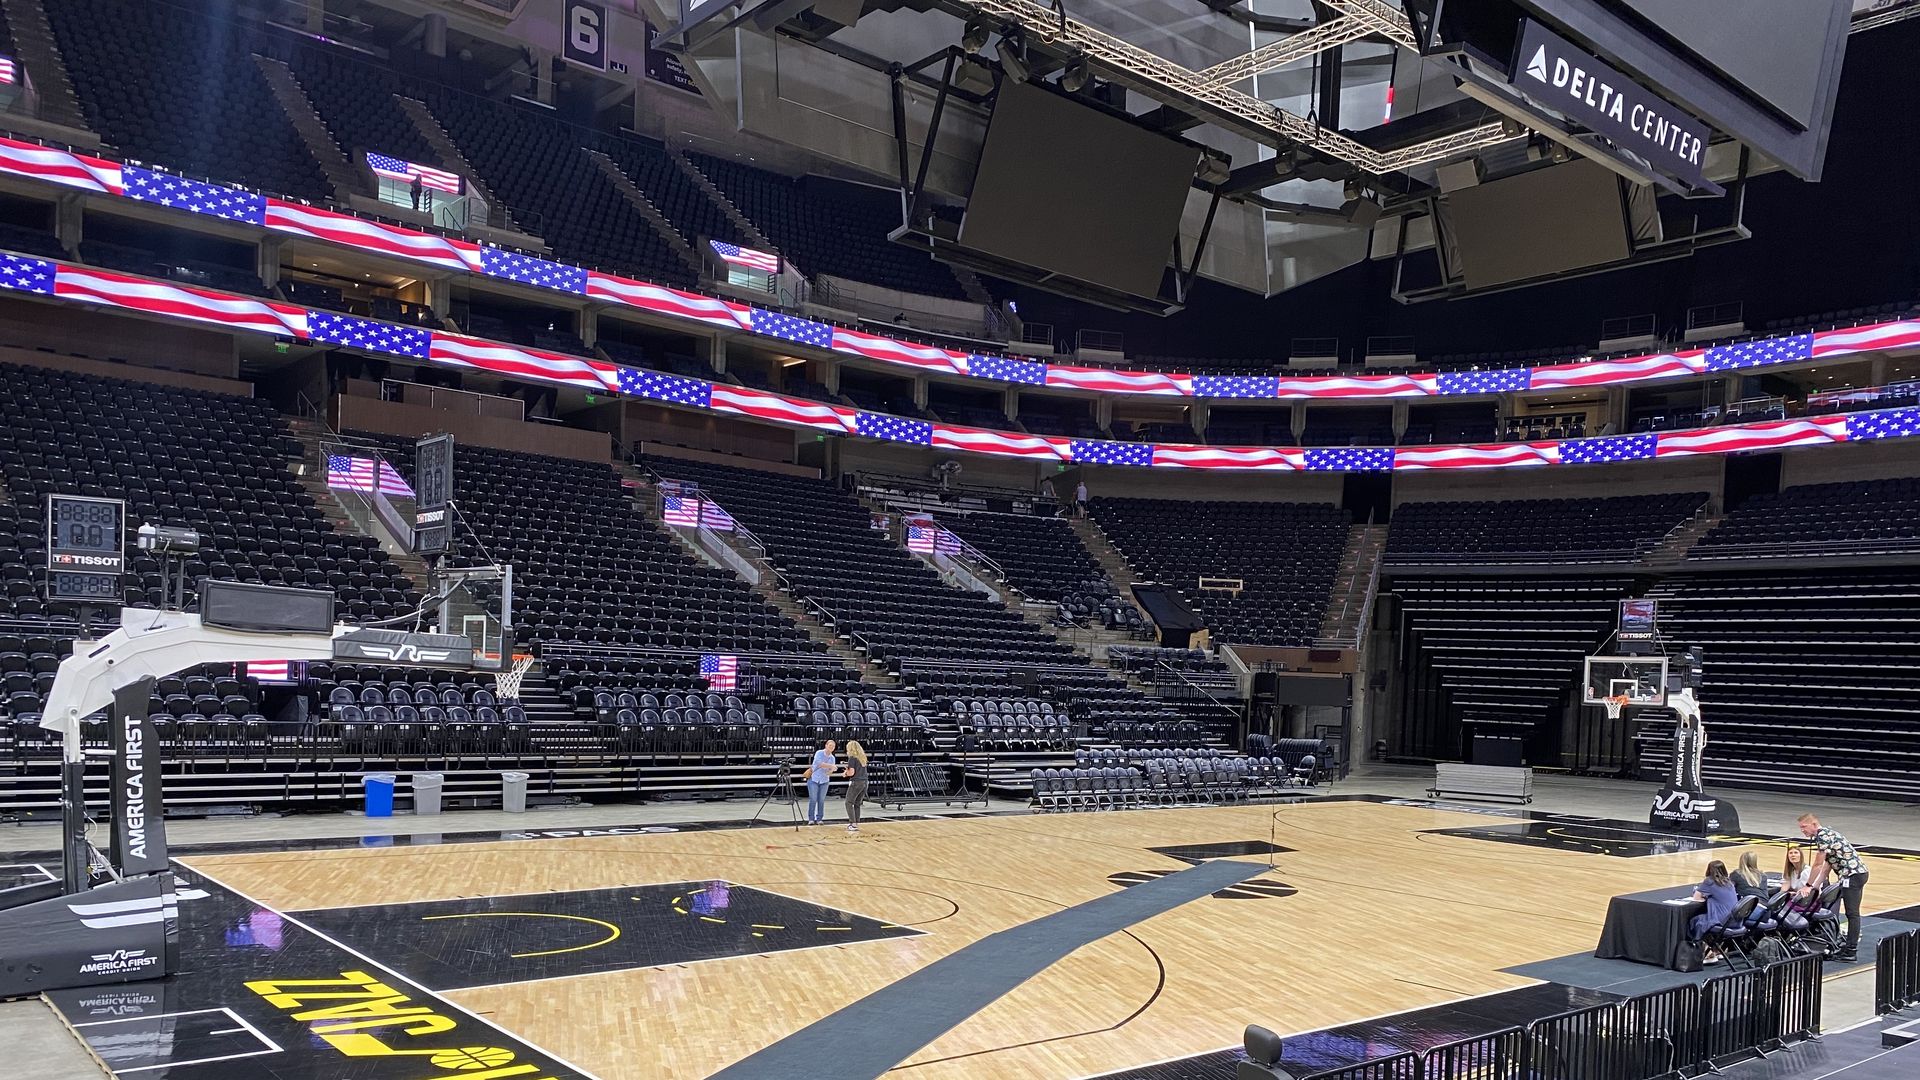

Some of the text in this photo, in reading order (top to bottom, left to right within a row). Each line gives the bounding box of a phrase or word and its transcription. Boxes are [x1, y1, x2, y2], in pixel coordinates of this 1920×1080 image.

[571, 5, 599, 54] 6
[1553, 57, 1701, 166] DELTA CENTER
[424, 510, 445, 523] TISSOT
[73, 555, 121, 567] TISSOT
[1675, 730, 1687, 787] AMERICA FIRST
[125, 715, 148, 860] AMERICA FIRST
[1653, 809, 1681, 818] AMERICA
[1681, 812, 1700, 820] FIRST
[79, 956, 158, 973] AMERICA FIRST
